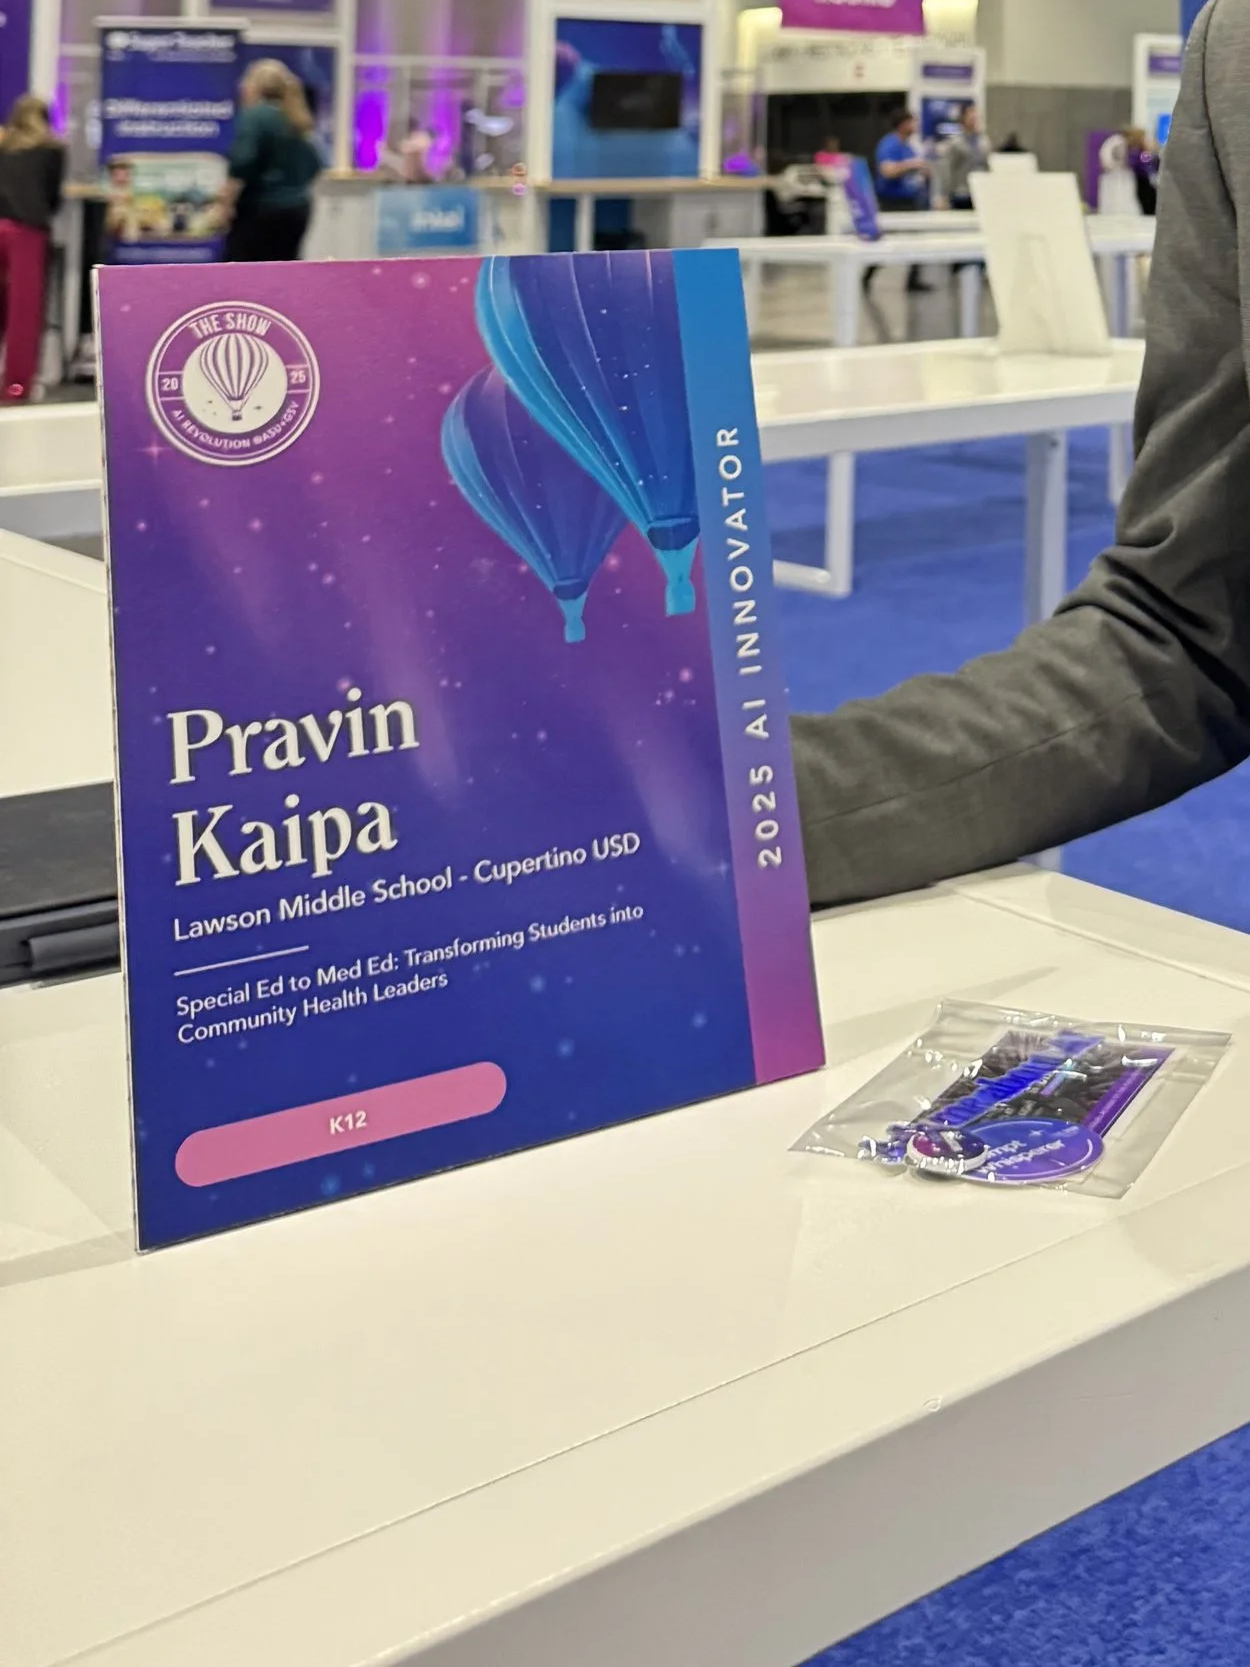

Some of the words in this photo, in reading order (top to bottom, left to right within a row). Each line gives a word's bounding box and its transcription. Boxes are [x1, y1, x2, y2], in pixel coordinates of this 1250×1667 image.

[189, 315, 222, 339] THE
[225, 313, 272, 336] SHOW
[161, 377, 178, 391] 20
[290, 370, 306, 384] 25
[172, 409, 183, 422] AI
[182, 417, 250, 450] REVOLUTION
[716, 427, 763, 675] INNOVATOR
[166, 687, 420, 784] Pravin
[742, 699, 770, 739] AI
[172, 793, 399, 886] Kaipa
[749, 765, 783, 871] 2025
[173, 907, 271, 942] Lawson
[279, 885, 366, 921] Middle
[372, 866, 452, 903] School
[473, 846, 587, 885] Cupertino
[591, 832, 641, 860] USD
[176, 982, 250, 1020] Special
[256, 975, 284, 999] Ed
[288, 976, 311, 992] to
[316, 959, 362, 986] Med
[367, 952, 400, 975] Ed:
[404, 931, 524, 968] Transforming
[527, 915, 606, 942] Students
[609, 905, 644, 924] into
[178, 1005, 297, 1045] Community
[303, 986, 368, 1017] Health
[373, 972, 448, 1003] Leaders
[330, 1110, 367, 1135] K12
